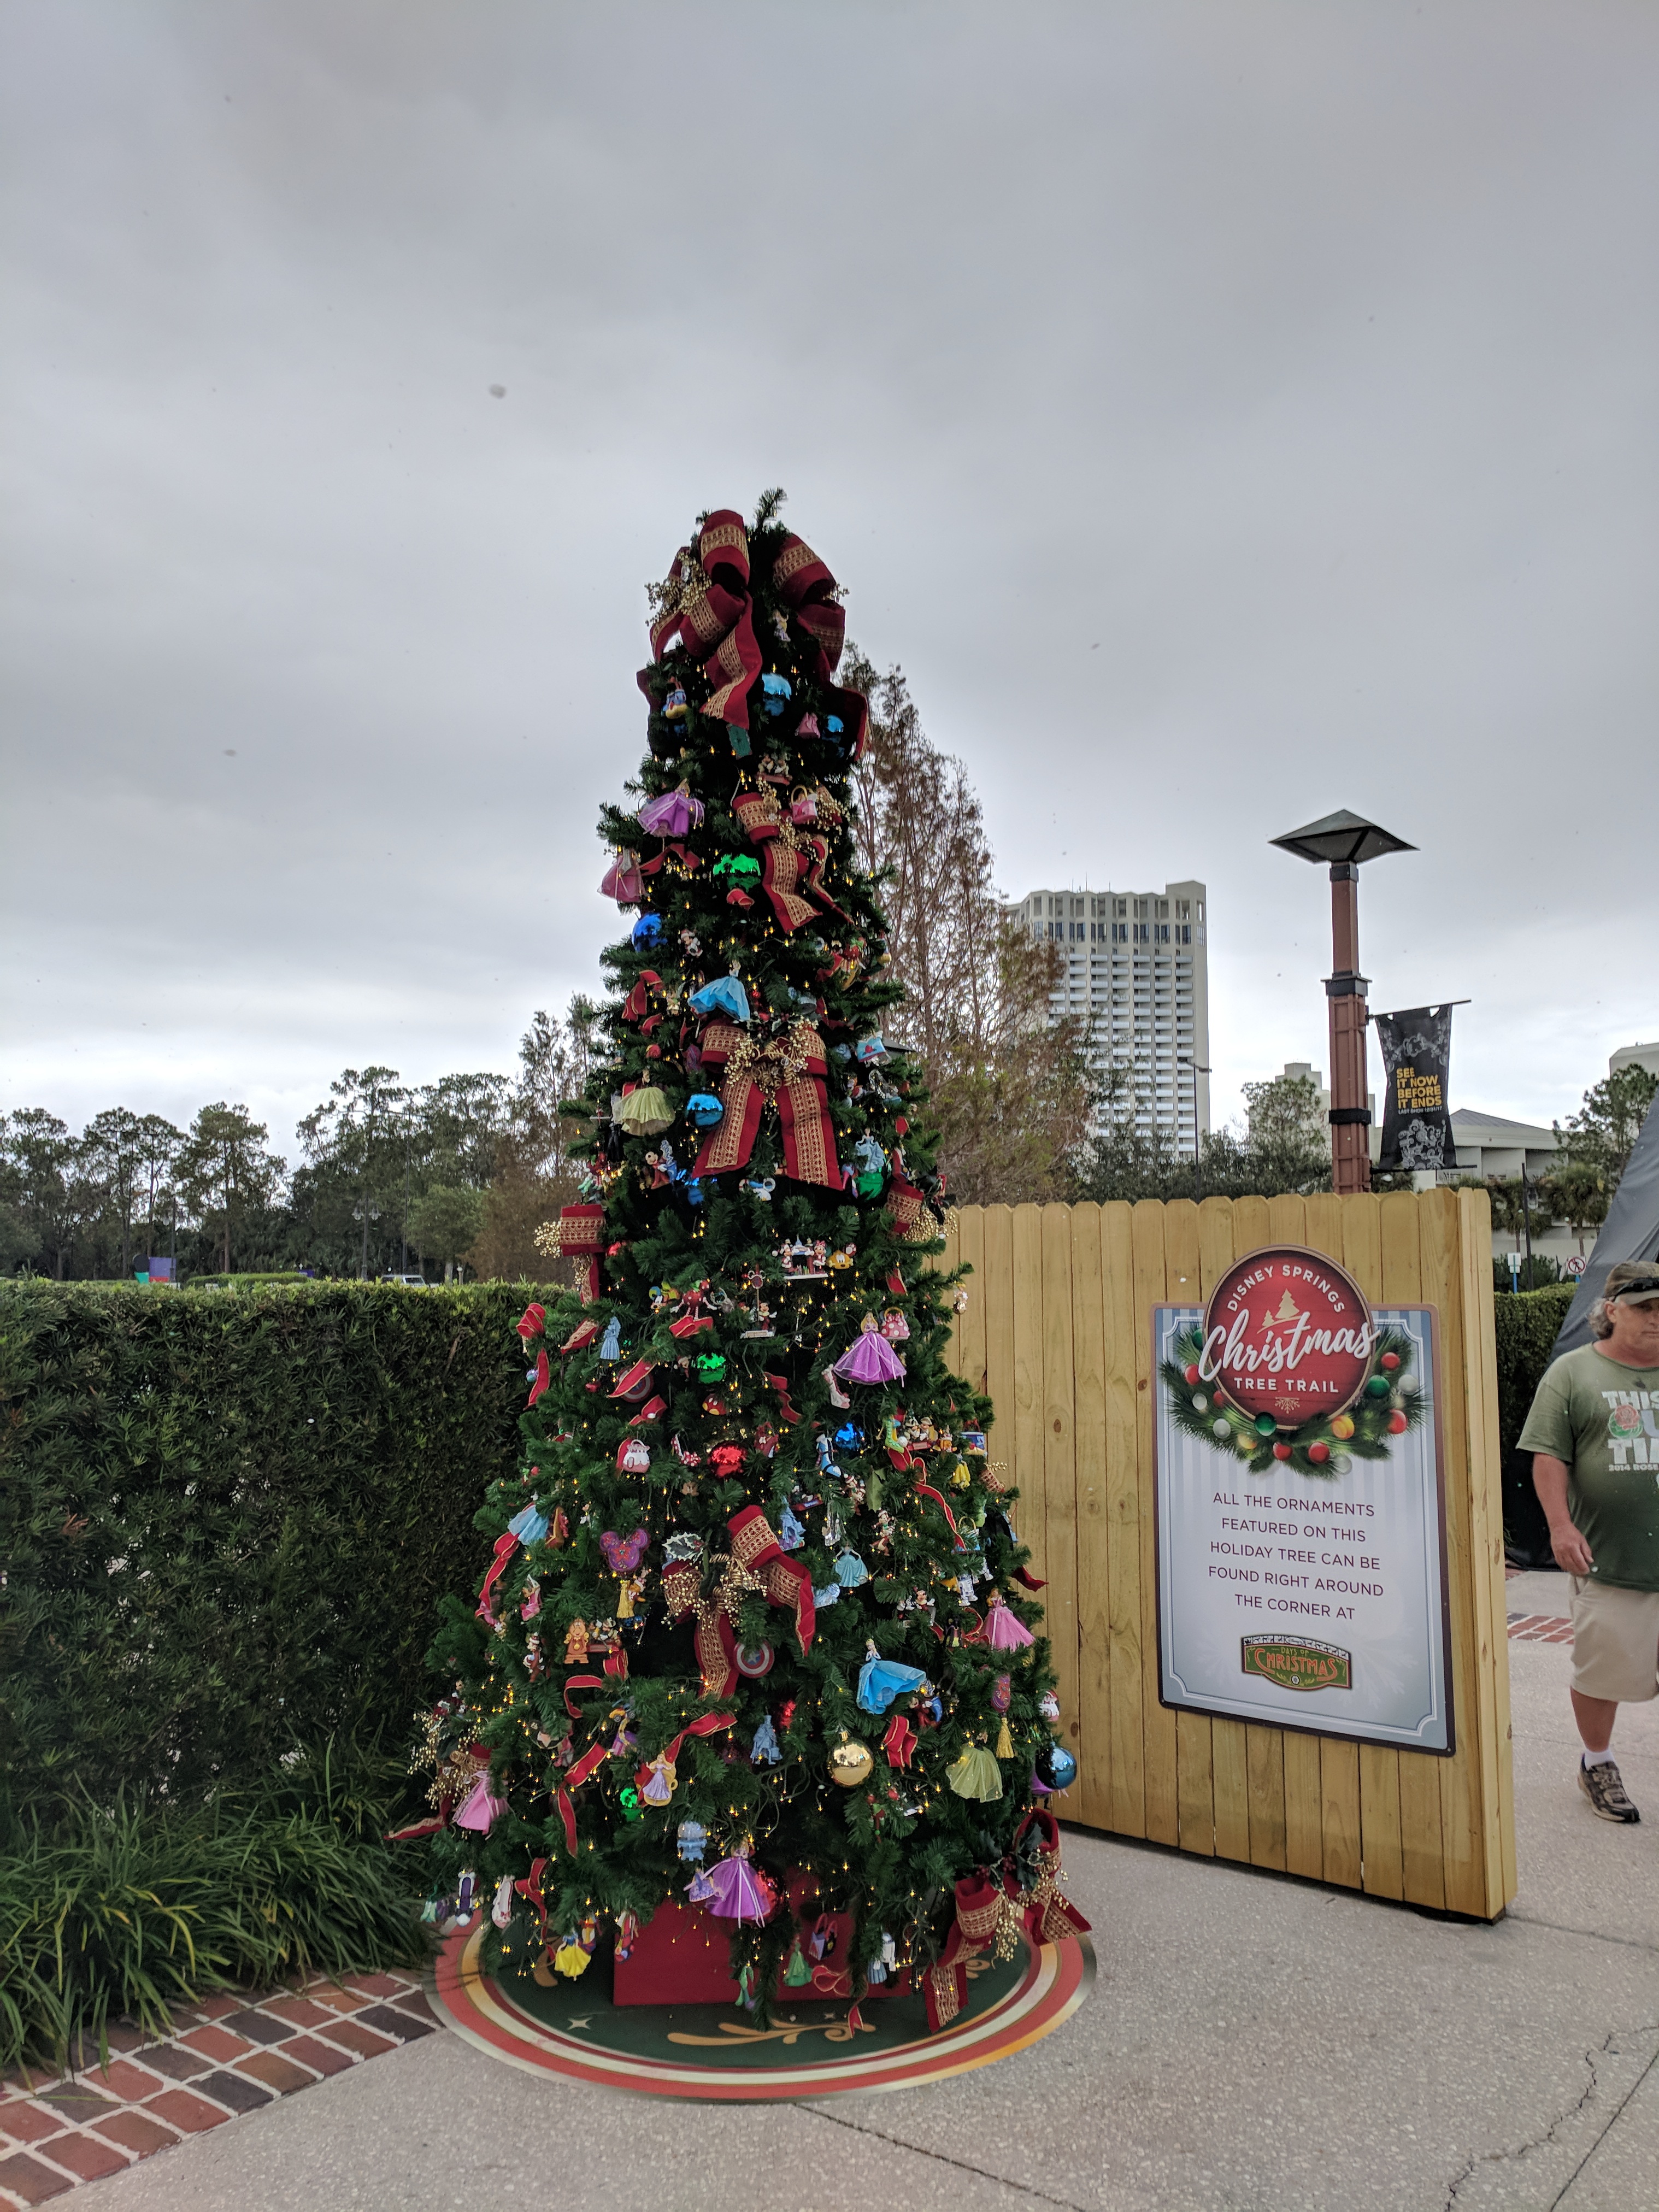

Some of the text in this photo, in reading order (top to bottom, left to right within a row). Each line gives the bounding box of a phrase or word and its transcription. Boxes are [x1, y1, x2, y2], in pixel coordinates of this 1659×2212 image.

[1396, 1067, 1415, 1079] SEE
[1397, 1074, 1438, 1089] IT NOW
[1397, 1085, 1442, 1099] BEFORE
[1398, 1095, 1442, 1109] IT ENDS
[1227, 1264, 1345, 1313] DISNEY SPRINGS
[1198, 1309, 1380, 1382] Christmas
[1234, 1378, 1339, 1393] TREE TRAIL
[1633, 1463, 1659, 1471] ROSE
[1213, 1492, 1375, 1517] ALL THE ORNAMENTS
[1222, 1518, 1366, 1543] FEATURED ON THIS
[1210, 1542, 1380, 1570] HOLIDAY TREE CAN BE
[1209, 1567, 1384, 1597] FOUND RIGHT AROUND
[1235, 1594, 1355, 1620] THE CORNER AT
[1281, 1647, 1297, 1656] DAYS
[1255, 1648, 1338, 1681] CHRISTMAS
